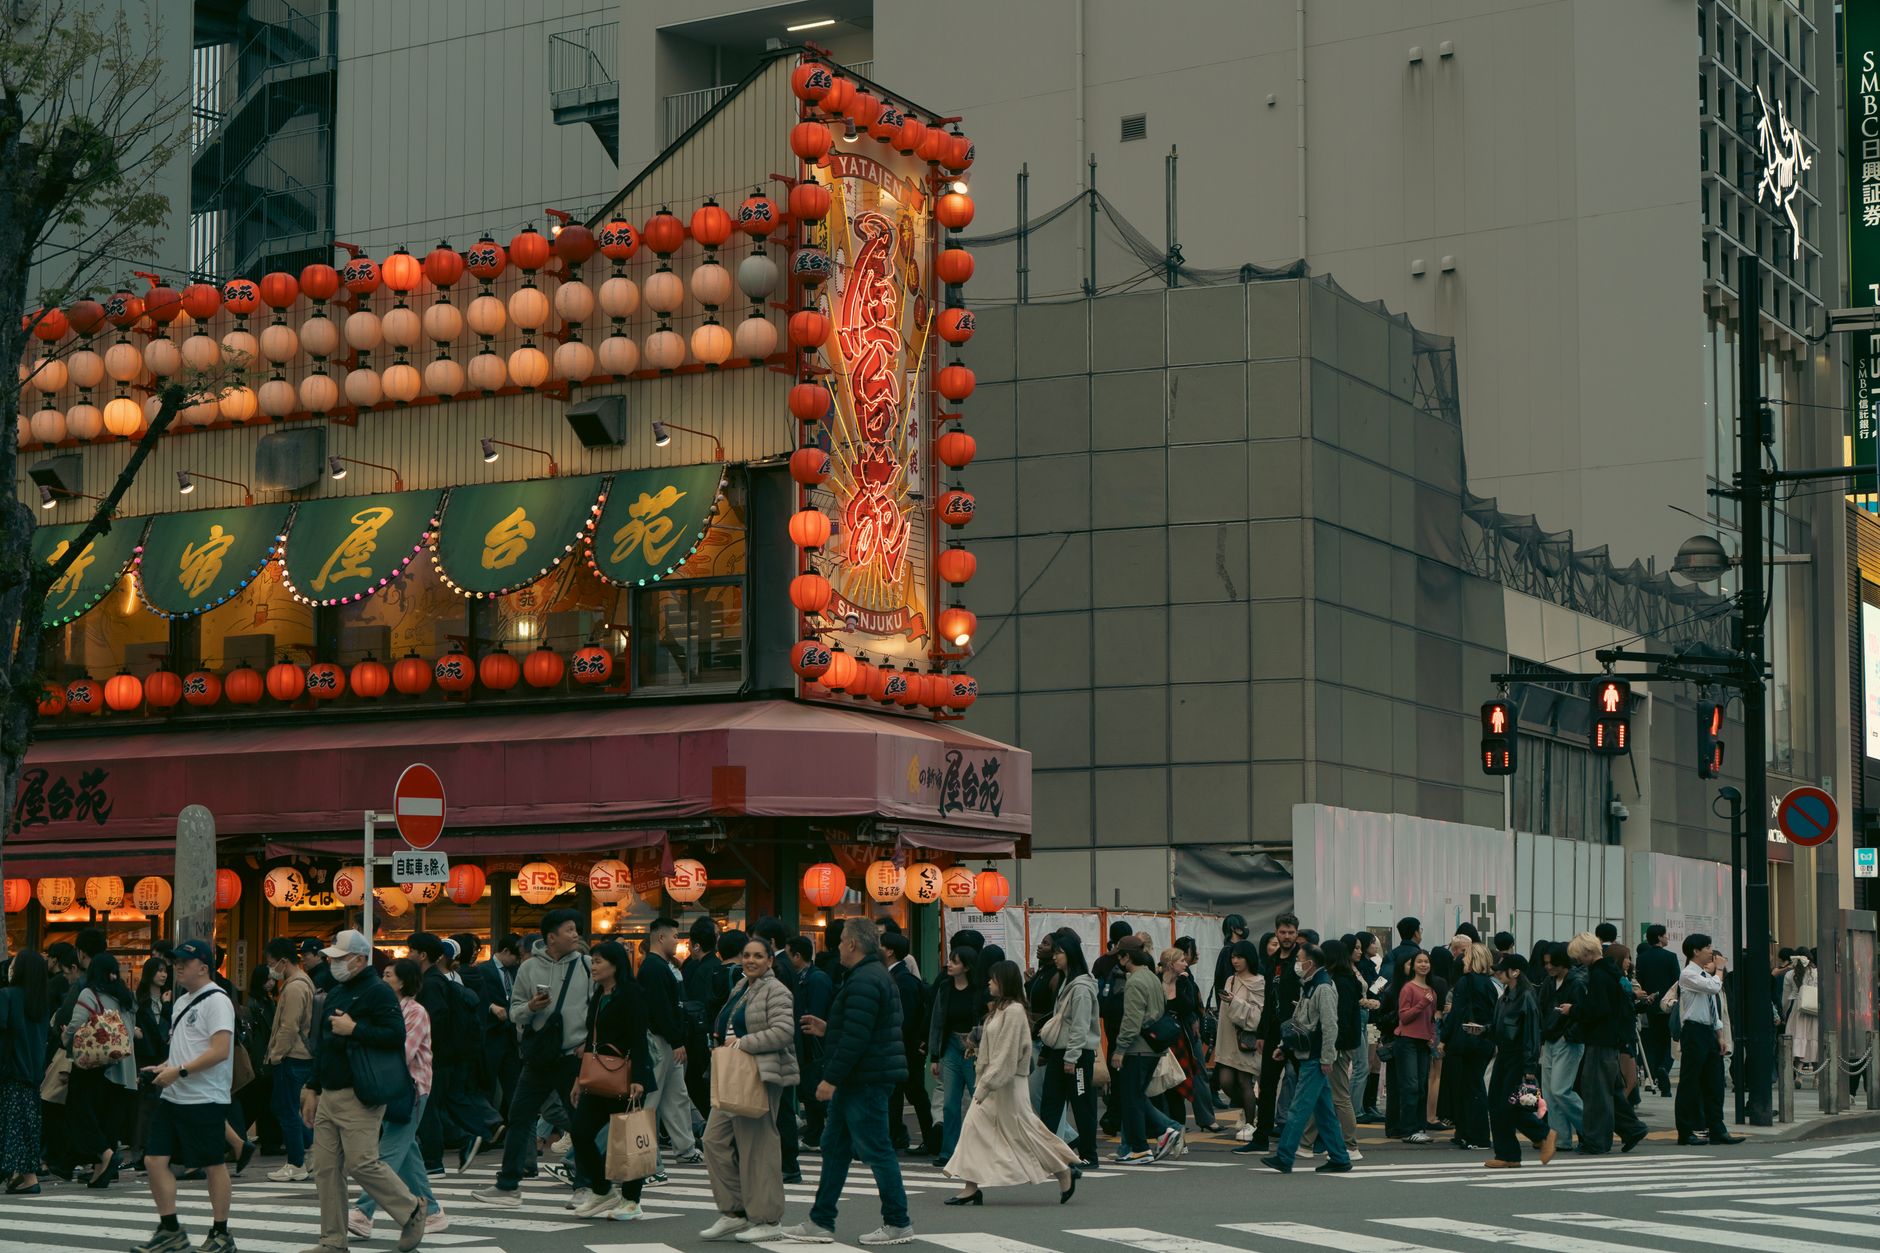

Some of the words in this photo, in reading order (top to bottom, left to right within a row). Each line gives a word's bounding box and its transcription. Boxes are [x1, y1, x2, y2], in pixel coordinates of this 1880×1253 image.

[839, 155, 902, 199] YATAIEN
[467, 249, 498, 268] 台苑
[344, 263, 374, 281] 台苑
[1858, 358, 1869, 439] SMBC信託銀行
[437, 661, 464, 680] 台苑
[307, 671, 337, 690] 台苑
[13, 768, 114, 834] 屋台苑
[397, 858, 446, 876] 自転車を除く
[532, 871, 558, 886] RS
[591, 877, 611, 889] RS
[917, 868, 934, 899] くろ松
[947, 883, 970, 895] RS
[635, 1134, 650, 1149] GU
